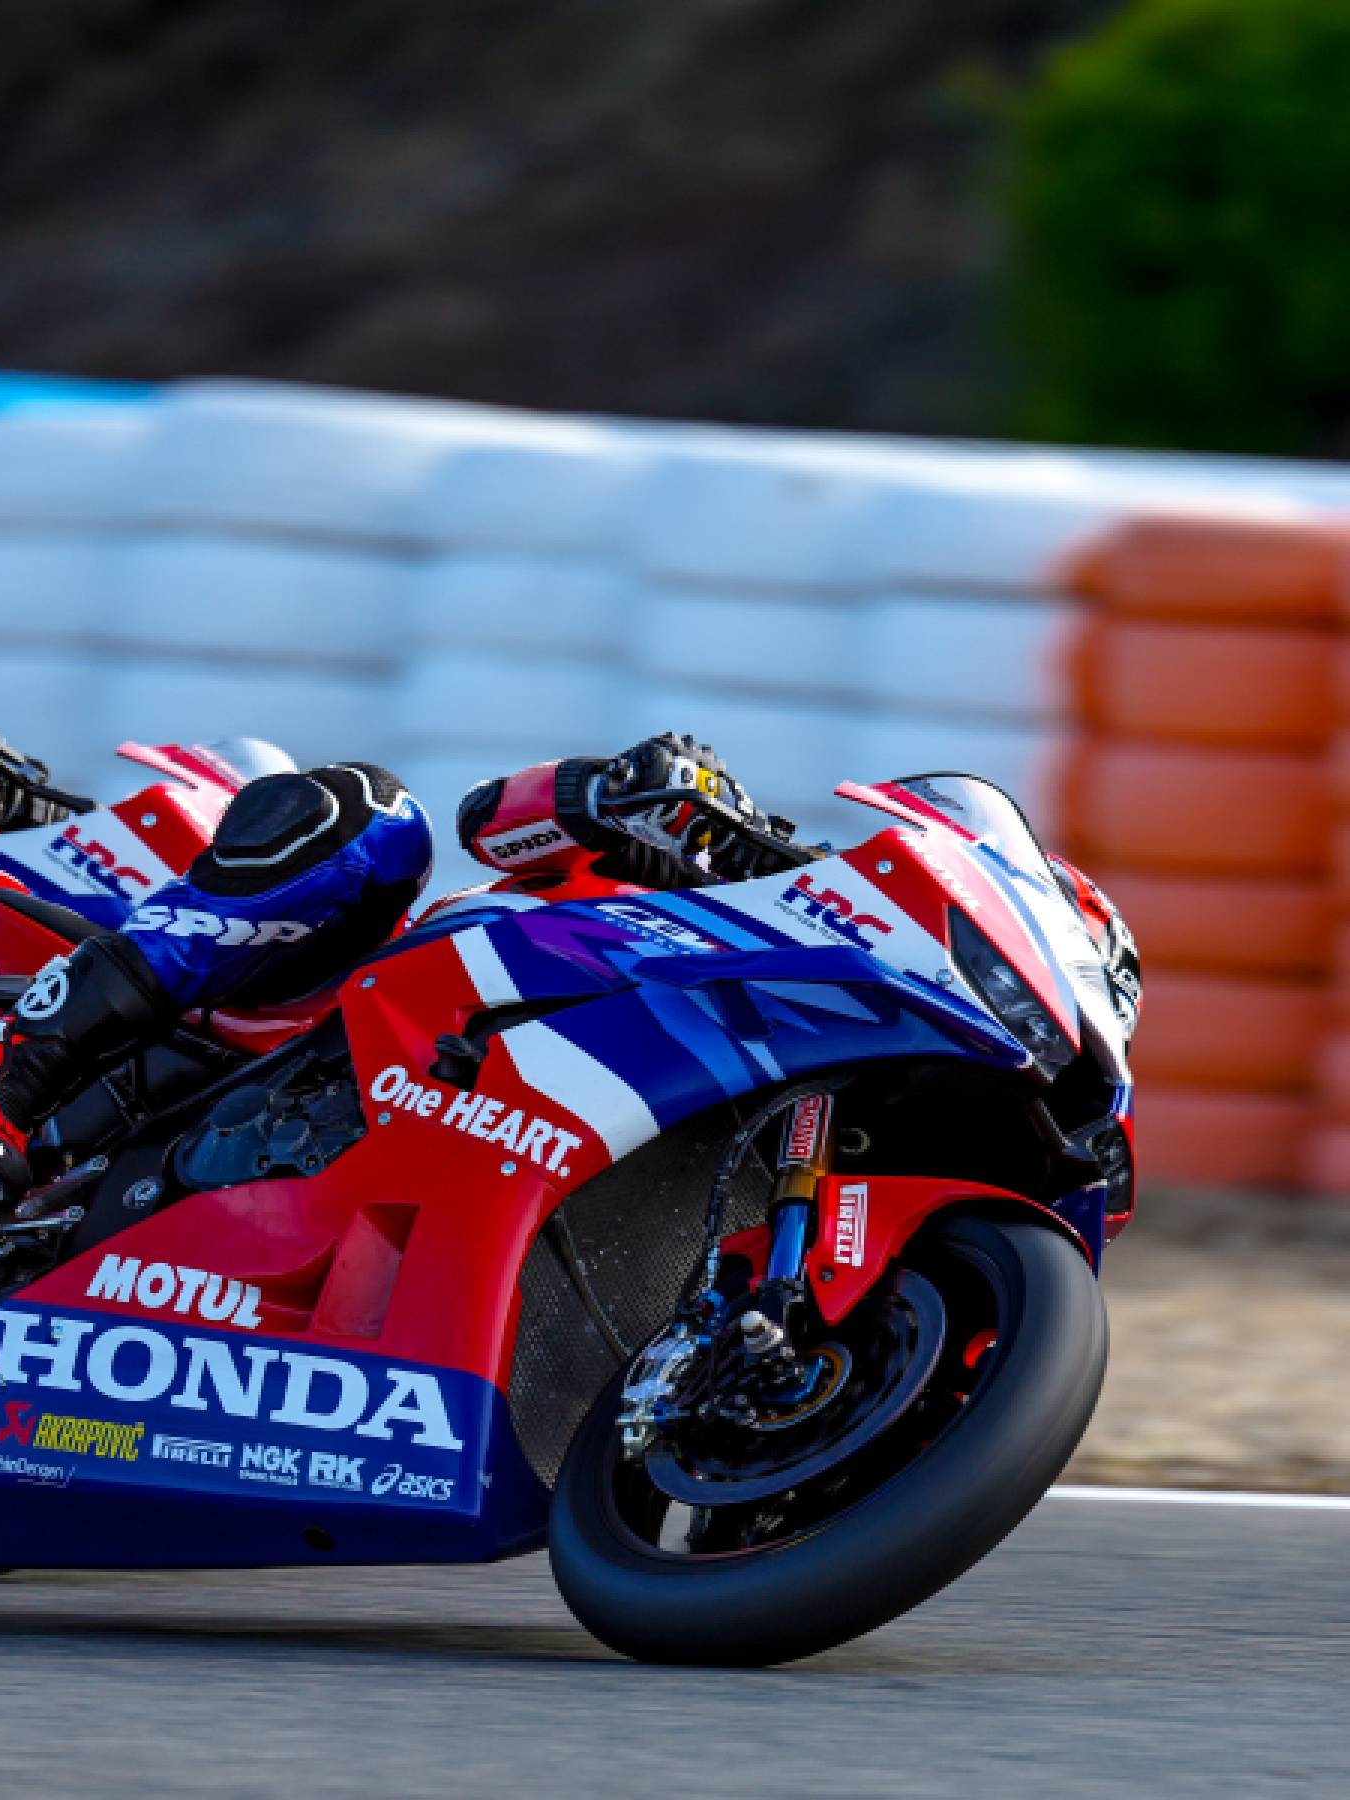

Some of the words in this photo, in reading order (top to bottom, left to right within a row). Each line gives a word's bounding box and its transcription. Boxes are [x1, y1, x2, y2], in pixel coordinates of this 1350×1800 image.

[118, 905, 325, 946] SPID
[779, 873, 894, 951] HRC
[369, 1065, 443, 1117] One
[440, 1091, 583, 1179] HEART.
[834, 1182, 868, 1267] PIRELLI
[86, 1253, 263, 1330] MOTUL
[152, 1434, 234, 1468] PIRELLI
[240, 1443, 302, 1475] NGK
[309, 1452, 366, 1485] RK
